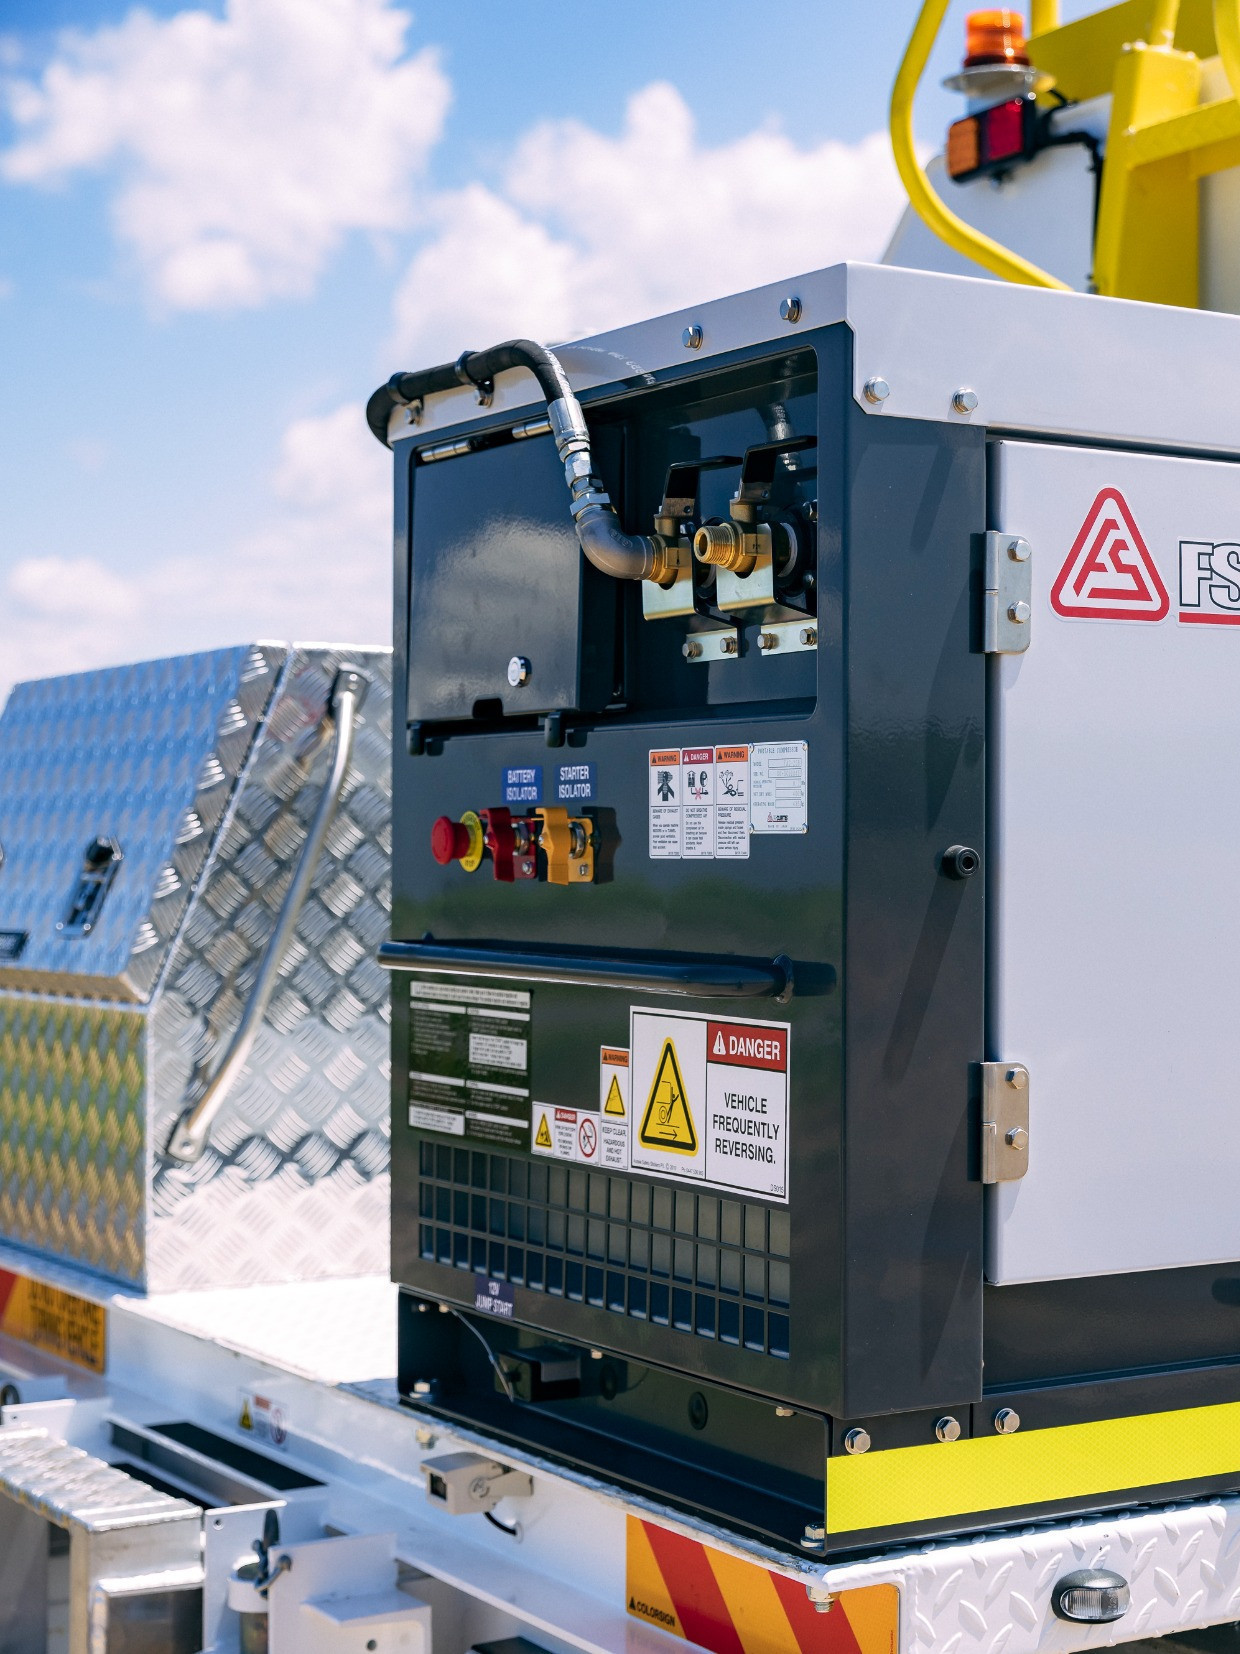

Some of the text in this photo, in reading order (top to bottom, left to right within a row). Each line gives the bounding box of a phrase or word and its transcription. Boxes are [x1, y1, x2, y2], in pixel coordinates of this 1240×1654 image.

[690, 752, 709, 761] DANGER
[724, 750, 745, 759] WARNING
[507, 769, 536, 784] BATTERY
[560, 765, 590, 781] STARTER
[506, 786, 537, 800] ISOLATOR
[559, 783, 591, 798] ISOLATOR
[729, 1035, 780, 1061] DANGER
[724, 1092, 767, 1114] VEHICLE
[713, 1114, 780, 1140] FREQUENTLY
[715, 1138, 776, 1164] REVERSING.
[475, 1294, 513, 1316] JUMP START
[637, 1601, 676, 1627] COLORSIGN
